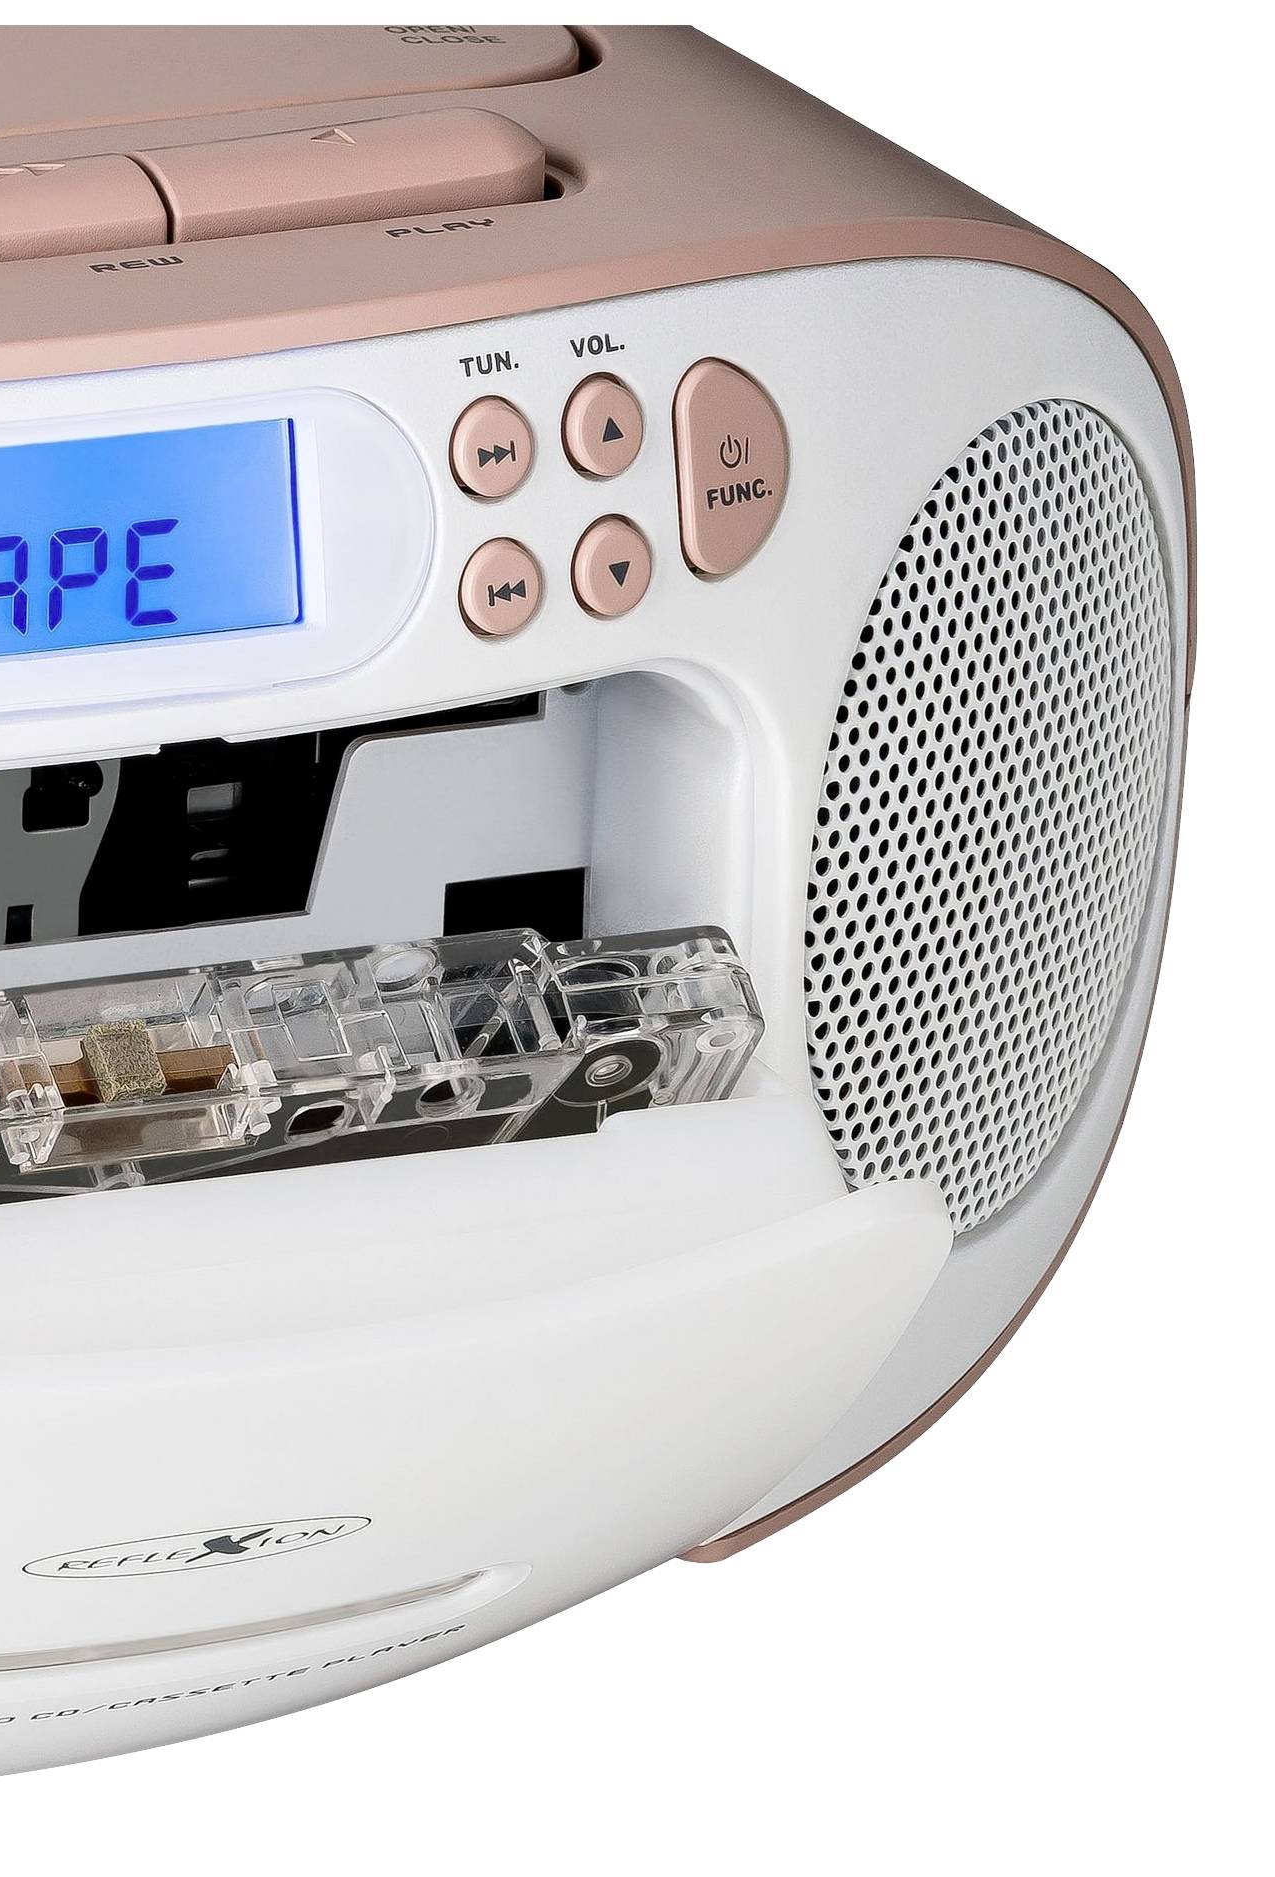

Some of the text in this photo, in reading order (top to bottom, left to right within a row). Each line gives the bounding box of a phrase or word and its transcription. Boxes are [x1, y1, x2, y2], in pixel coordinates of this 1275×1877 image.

[400, 36, 507, 44] CLOSE
[386, 218, 495, 239] PLAY
[89, 255, 184, 273] REW
[570, 334, 625, 358] VOL.
[459, 351, 520, 377] TUN.
[706, 478, 773, 510] FUNC.
[29, 1667, 310, 1721] CD/CASSETTE
[321, 1623, 466, 1669] PLAYER
